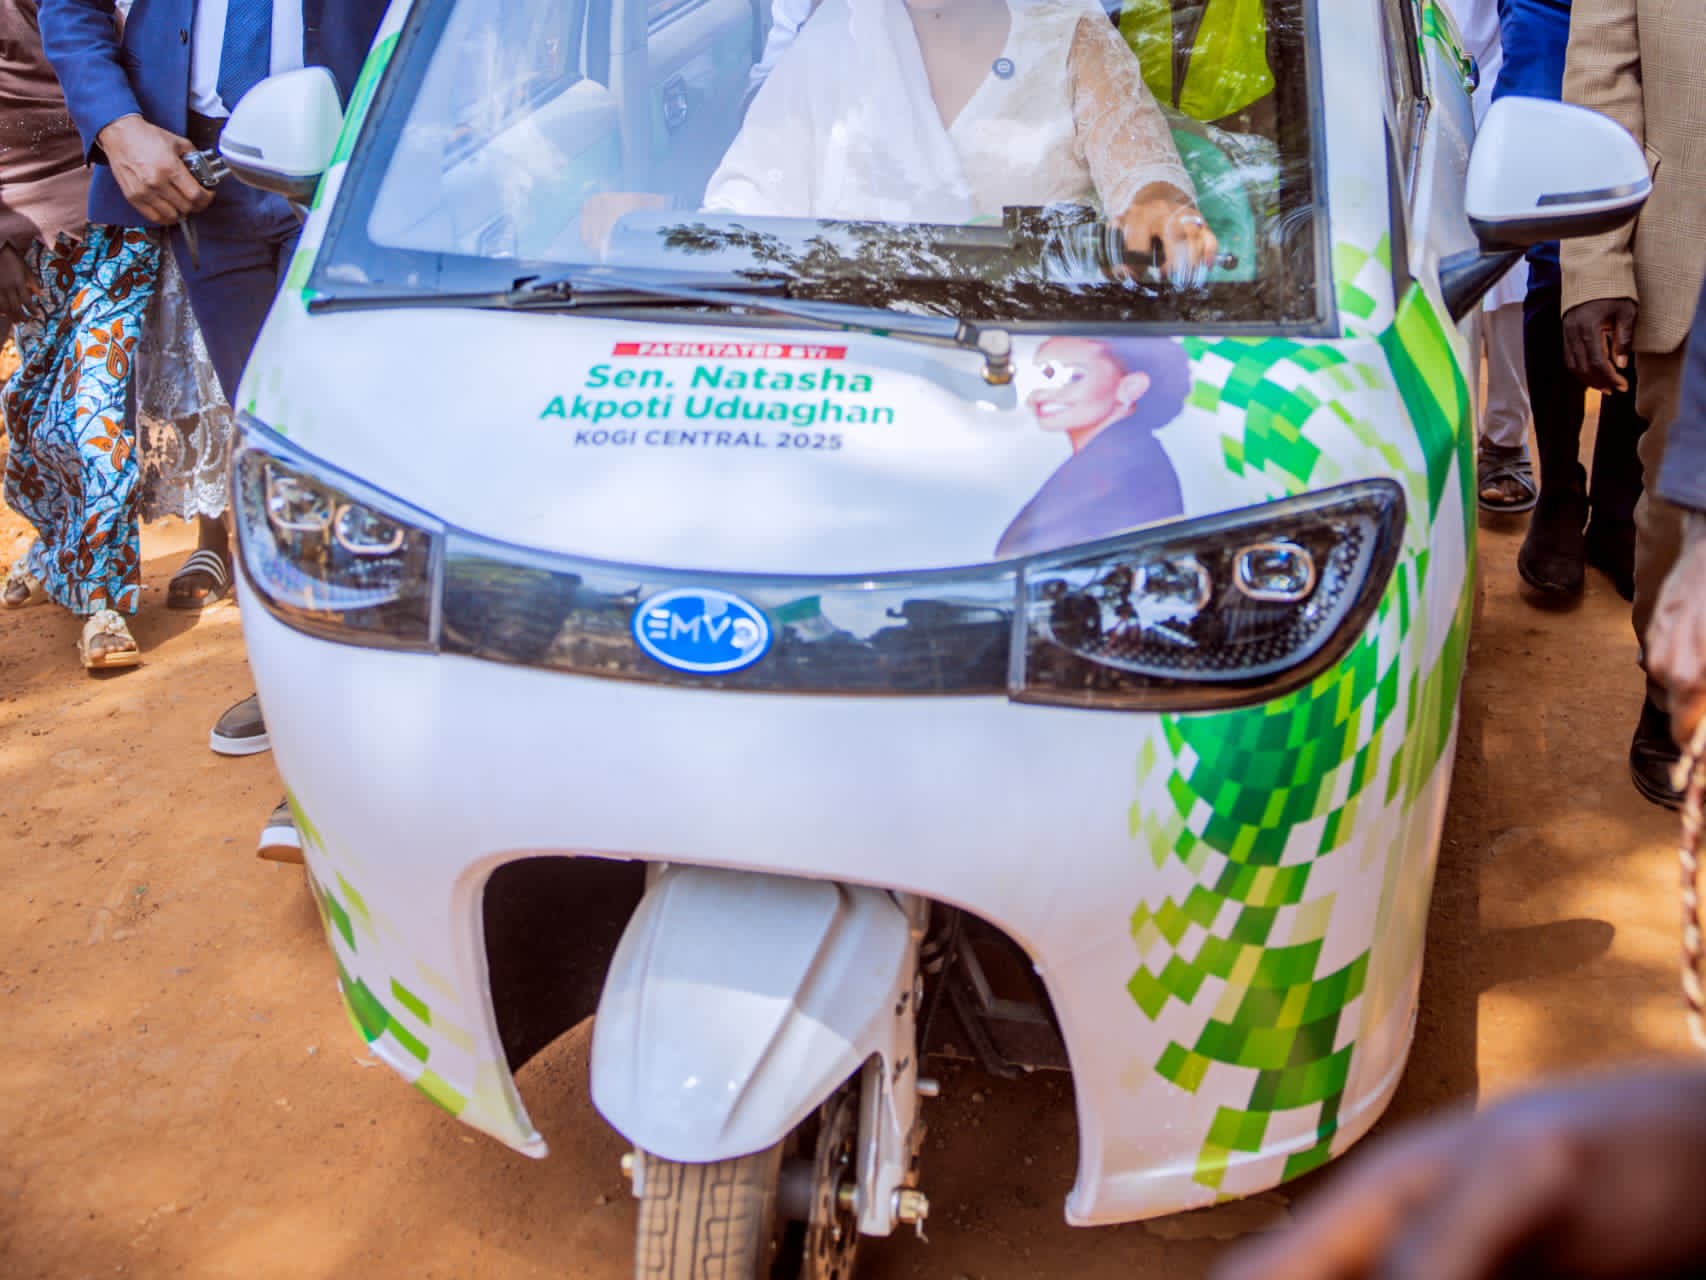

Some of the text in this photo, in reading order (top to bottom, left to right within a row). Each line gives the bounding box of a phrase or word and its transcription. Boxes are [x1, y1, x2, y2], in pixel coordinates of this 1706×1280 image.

[638, 343, 782, 359] FACILITATED
[584, 364, 873, 393] Sen. Natasha
[538, 394, 895, 428] Akpoti Uduaghan
[574, 429, 842, 451] KOGI CENTRAL 2025
